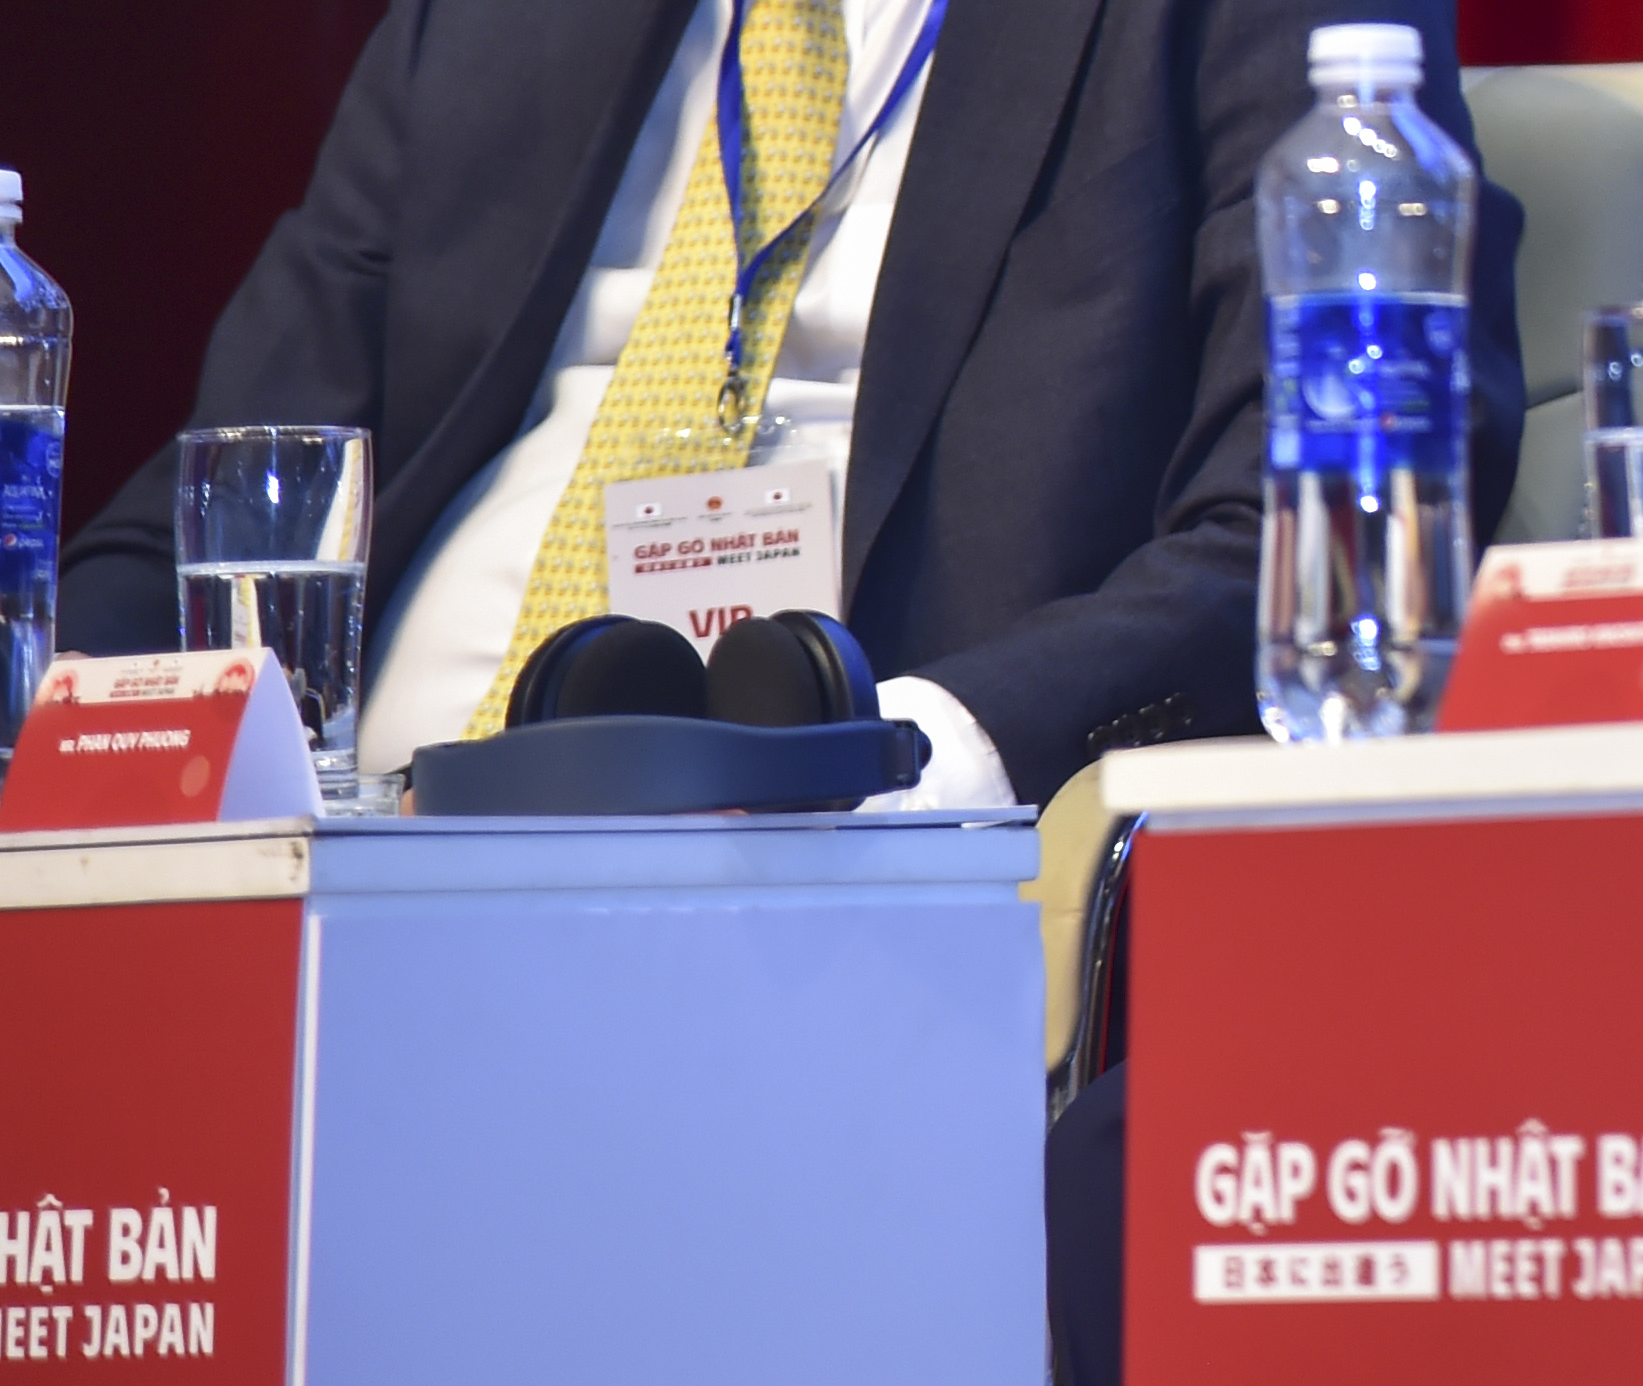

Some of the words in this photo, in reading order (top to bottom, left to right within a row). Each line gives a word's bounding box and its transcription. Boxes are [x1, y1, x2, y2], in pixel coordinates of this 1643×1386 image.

[1195, 1130, 1317, 1235] GẶP
[1326, 1127, 1419, 1224] GỠ
[1430, 1118, 1585, 1230] NHẬT
[108, 1187, 217, 1282] BẢN
[1447, 1236, 1567, 1300] MEET
[0, 1305, 73, 1359] EET
[82, 1302, 215, 1358] JAPAN
